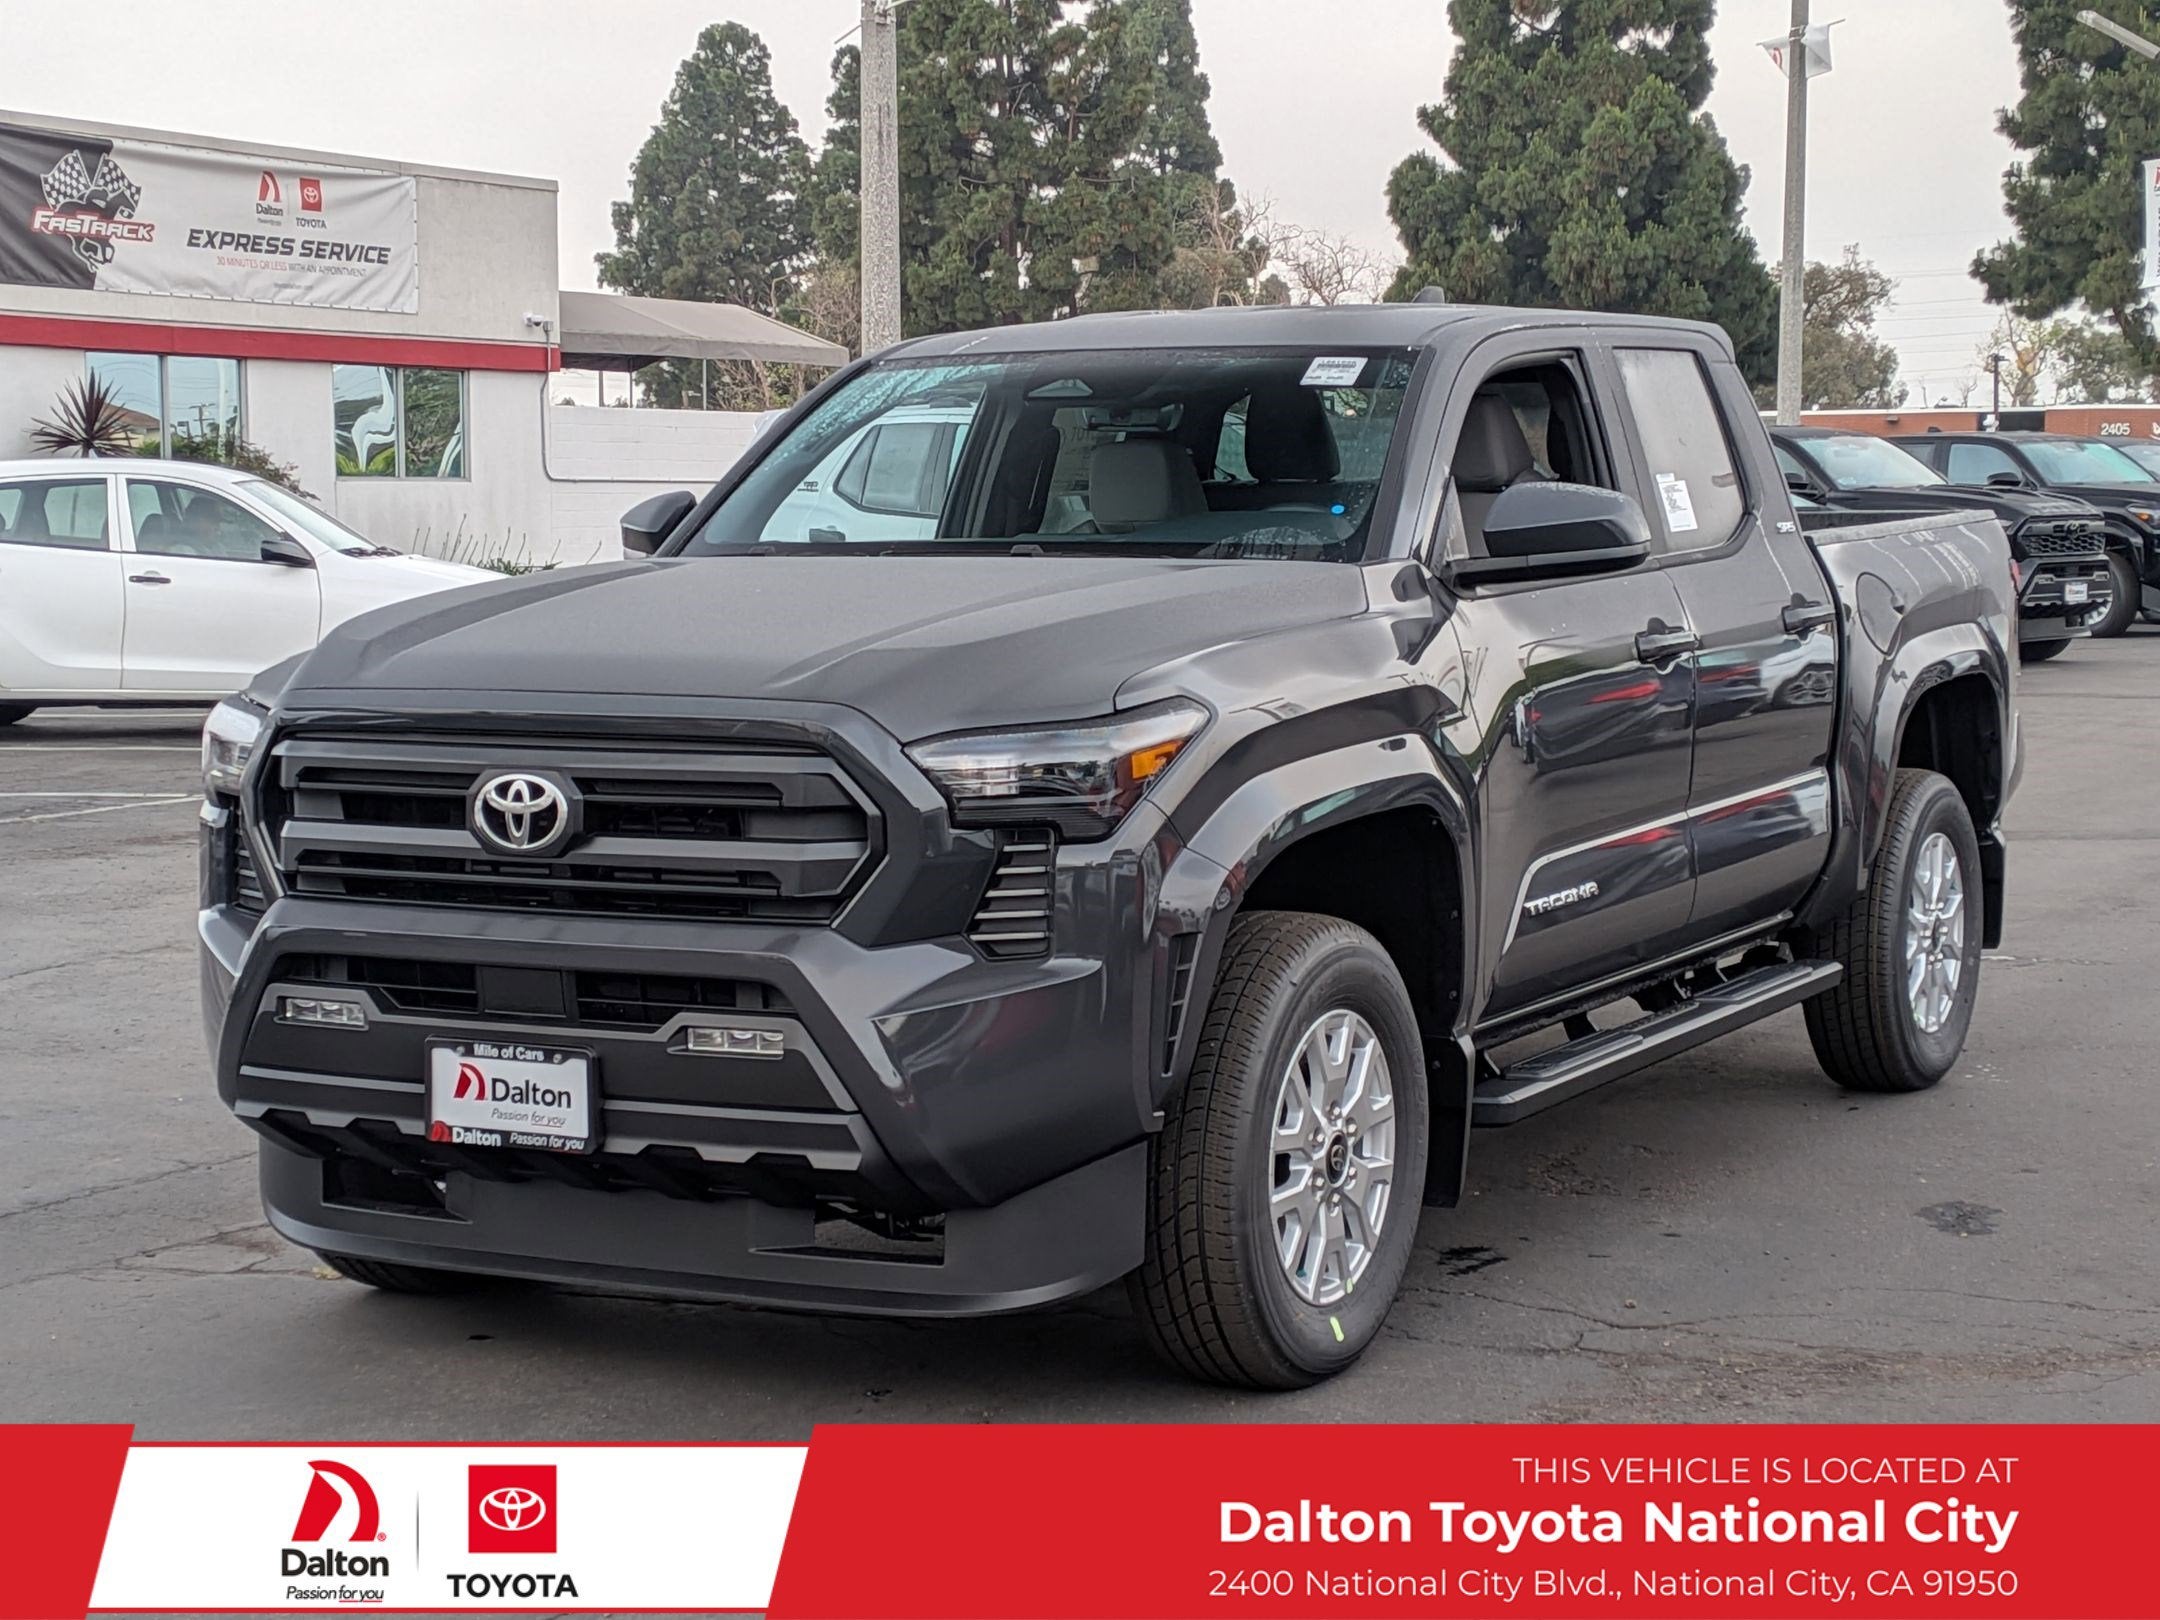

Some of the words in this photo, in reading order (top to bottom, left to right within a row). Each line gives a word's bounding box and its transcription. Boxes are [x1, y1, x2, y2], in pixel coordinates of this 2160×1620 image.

[256, 203, 284, 216] Dalton
[296, 217, 327, 229] TOYOTA
[186, 228, 296, 256] EXPRESS
[298, 239, 391, 265] SERVICE
[226, 256, 258, 269] MINUTES
[259, 260, 270, 270] OR
[270, 261, 288, 272] LESS
[288, 262, 306, 273] WITH
[306, 263, 317, 272] AN
[2100, 422, 2131, 436] 2405
[1523, 881, 1599, 915] TACOMA
[473, 1043, 499, 1058] Mile
[500, 1046, 515, 1059] of
[515, 1048, 545, 1062] Cars
[491, 1077, 572, 1109] Dalton
[491, 1107, 528, 1122] Passion
[530, 1111, 545, 1124] for
[547, 1114, 567, 1127] you
[452, 1127, 502, 1147] Dalton
[509, 1132, 549, 1148] Passion
[548, 1135, 565, 1149] for
[564, 1139, 586, 1150] you
